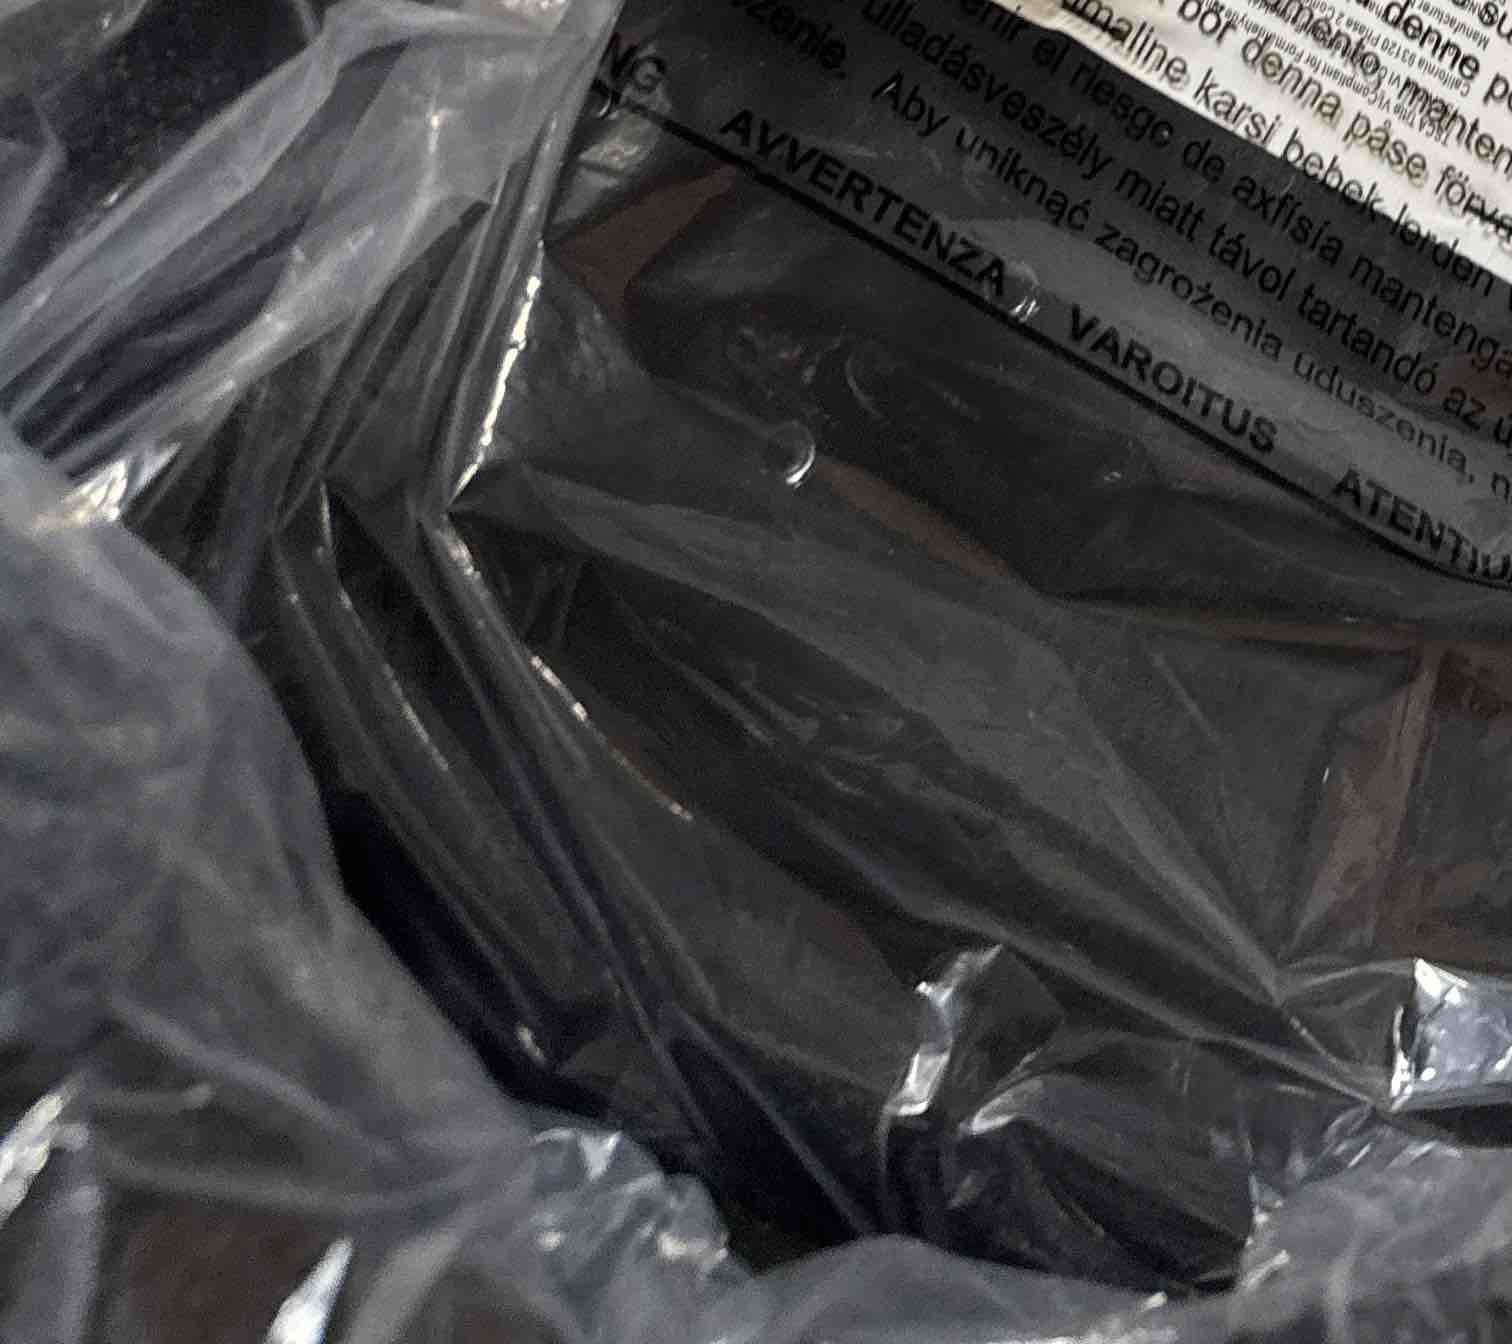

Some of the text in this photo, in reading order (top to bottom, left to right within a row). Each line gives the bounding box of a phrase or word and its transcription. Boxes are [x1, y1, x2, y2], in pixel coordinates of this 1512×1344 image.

[868, 64, 956, 144] Aby
[1176, 130, 1234, 187] de
[1190, 66, 1283, 144] karsi
[1236, 28, 1347, 122] denna
[1339, 103, 1434, 181] påse
[720, 108, 1281, 454] AVVERTENZA VAROITUS
[1112, 159, 1210, 244] miatt
[1202, 219, 1301, 303] távol
[1438, 384, 1491, 433] az
